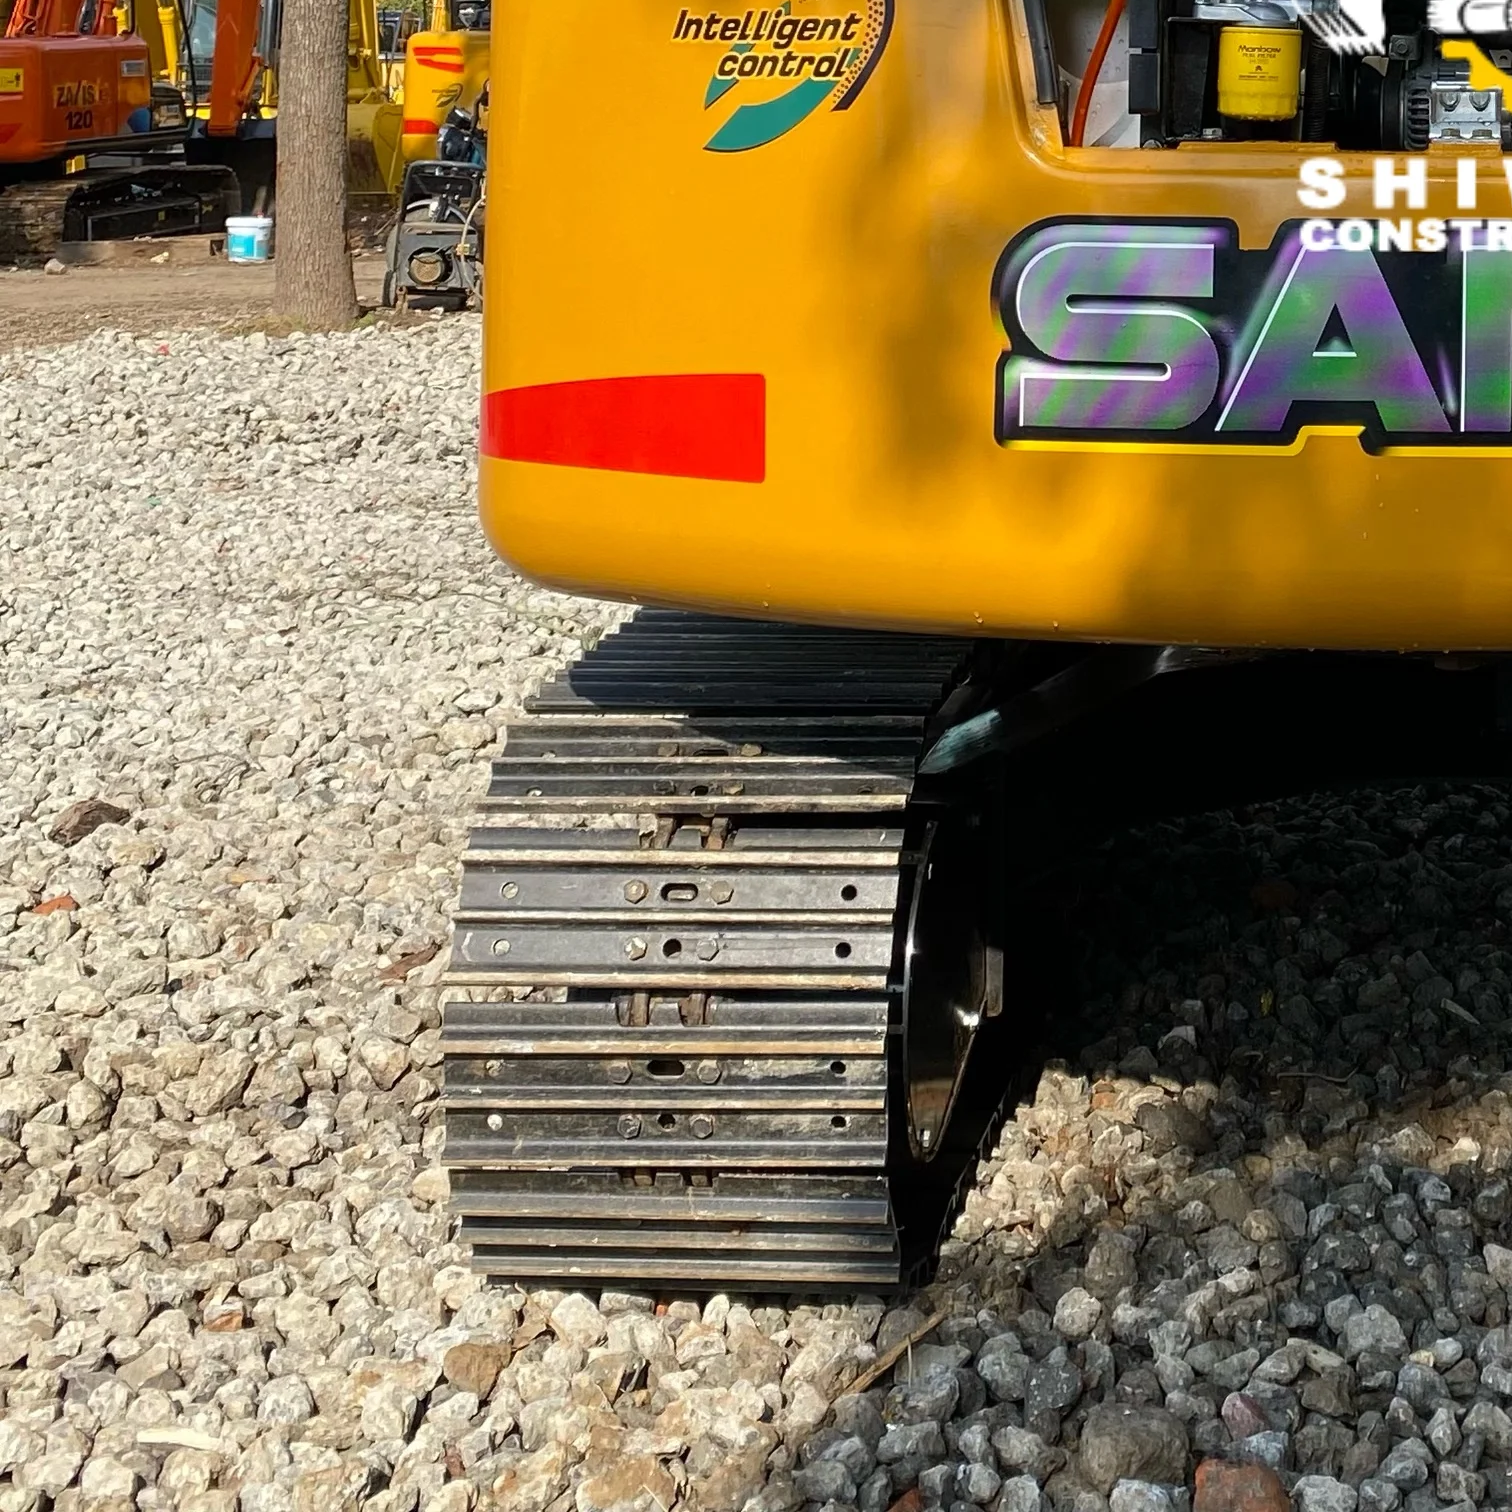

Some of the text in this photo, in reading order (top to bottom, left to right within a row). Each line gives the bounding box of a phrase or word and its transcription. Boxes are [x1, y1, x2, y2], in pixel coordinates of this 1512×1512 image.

[672, 8, 864, 50] Intelligent
[716, 46, 851, 78] control
[65, 110, 93, 131] 120
